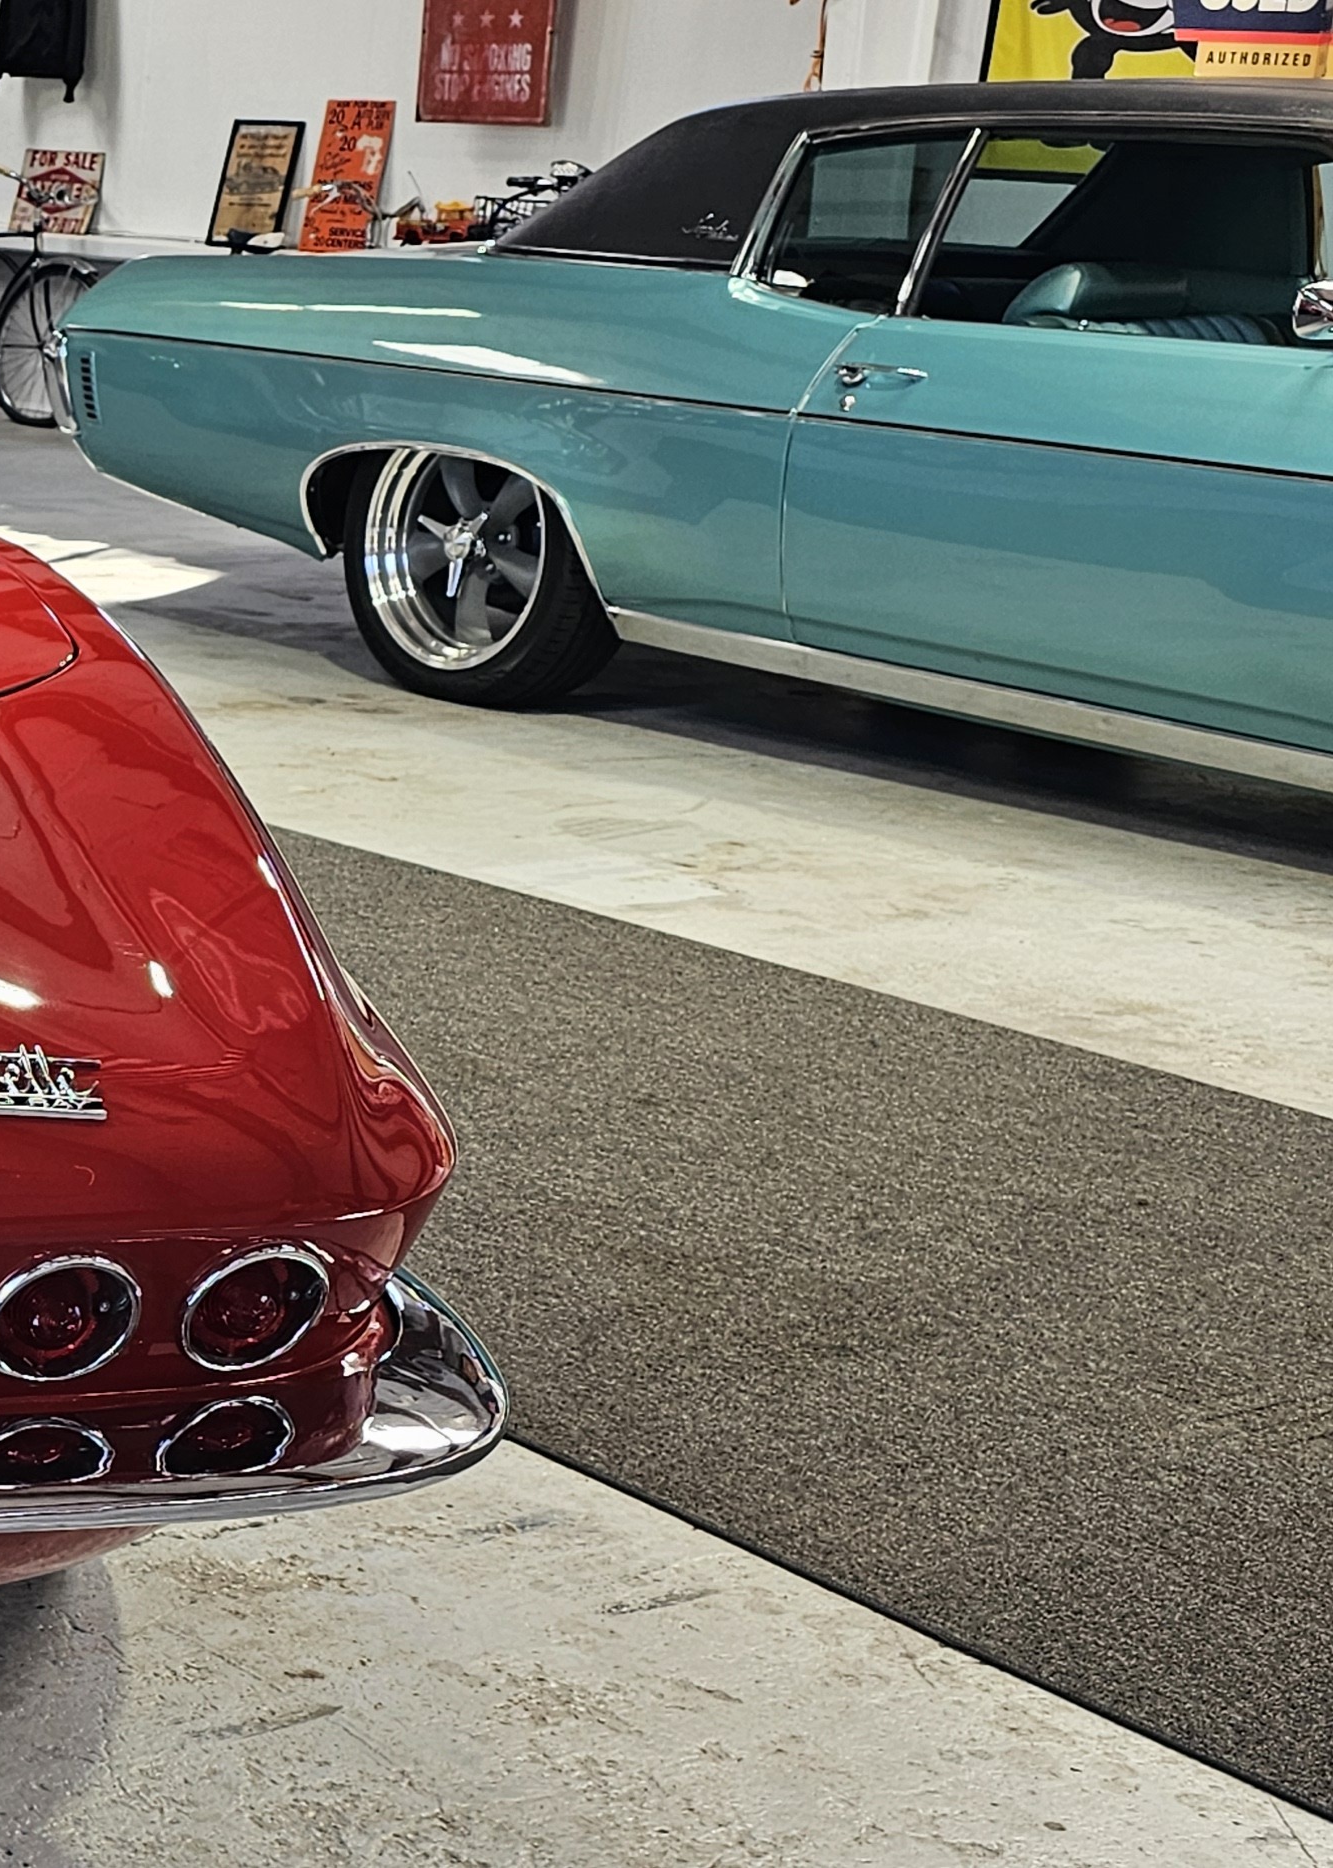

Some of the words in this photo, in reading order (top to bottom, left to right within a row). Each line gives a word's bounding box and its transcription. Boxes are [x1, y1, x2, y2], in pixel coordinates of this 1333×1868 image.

[462, 43, 532, 71] SOKING
[1206, 50, 1312, 66] AUTHORIZED
[29, 149, 58, 168] FOR
[63, 151, 99, 171] SALE
